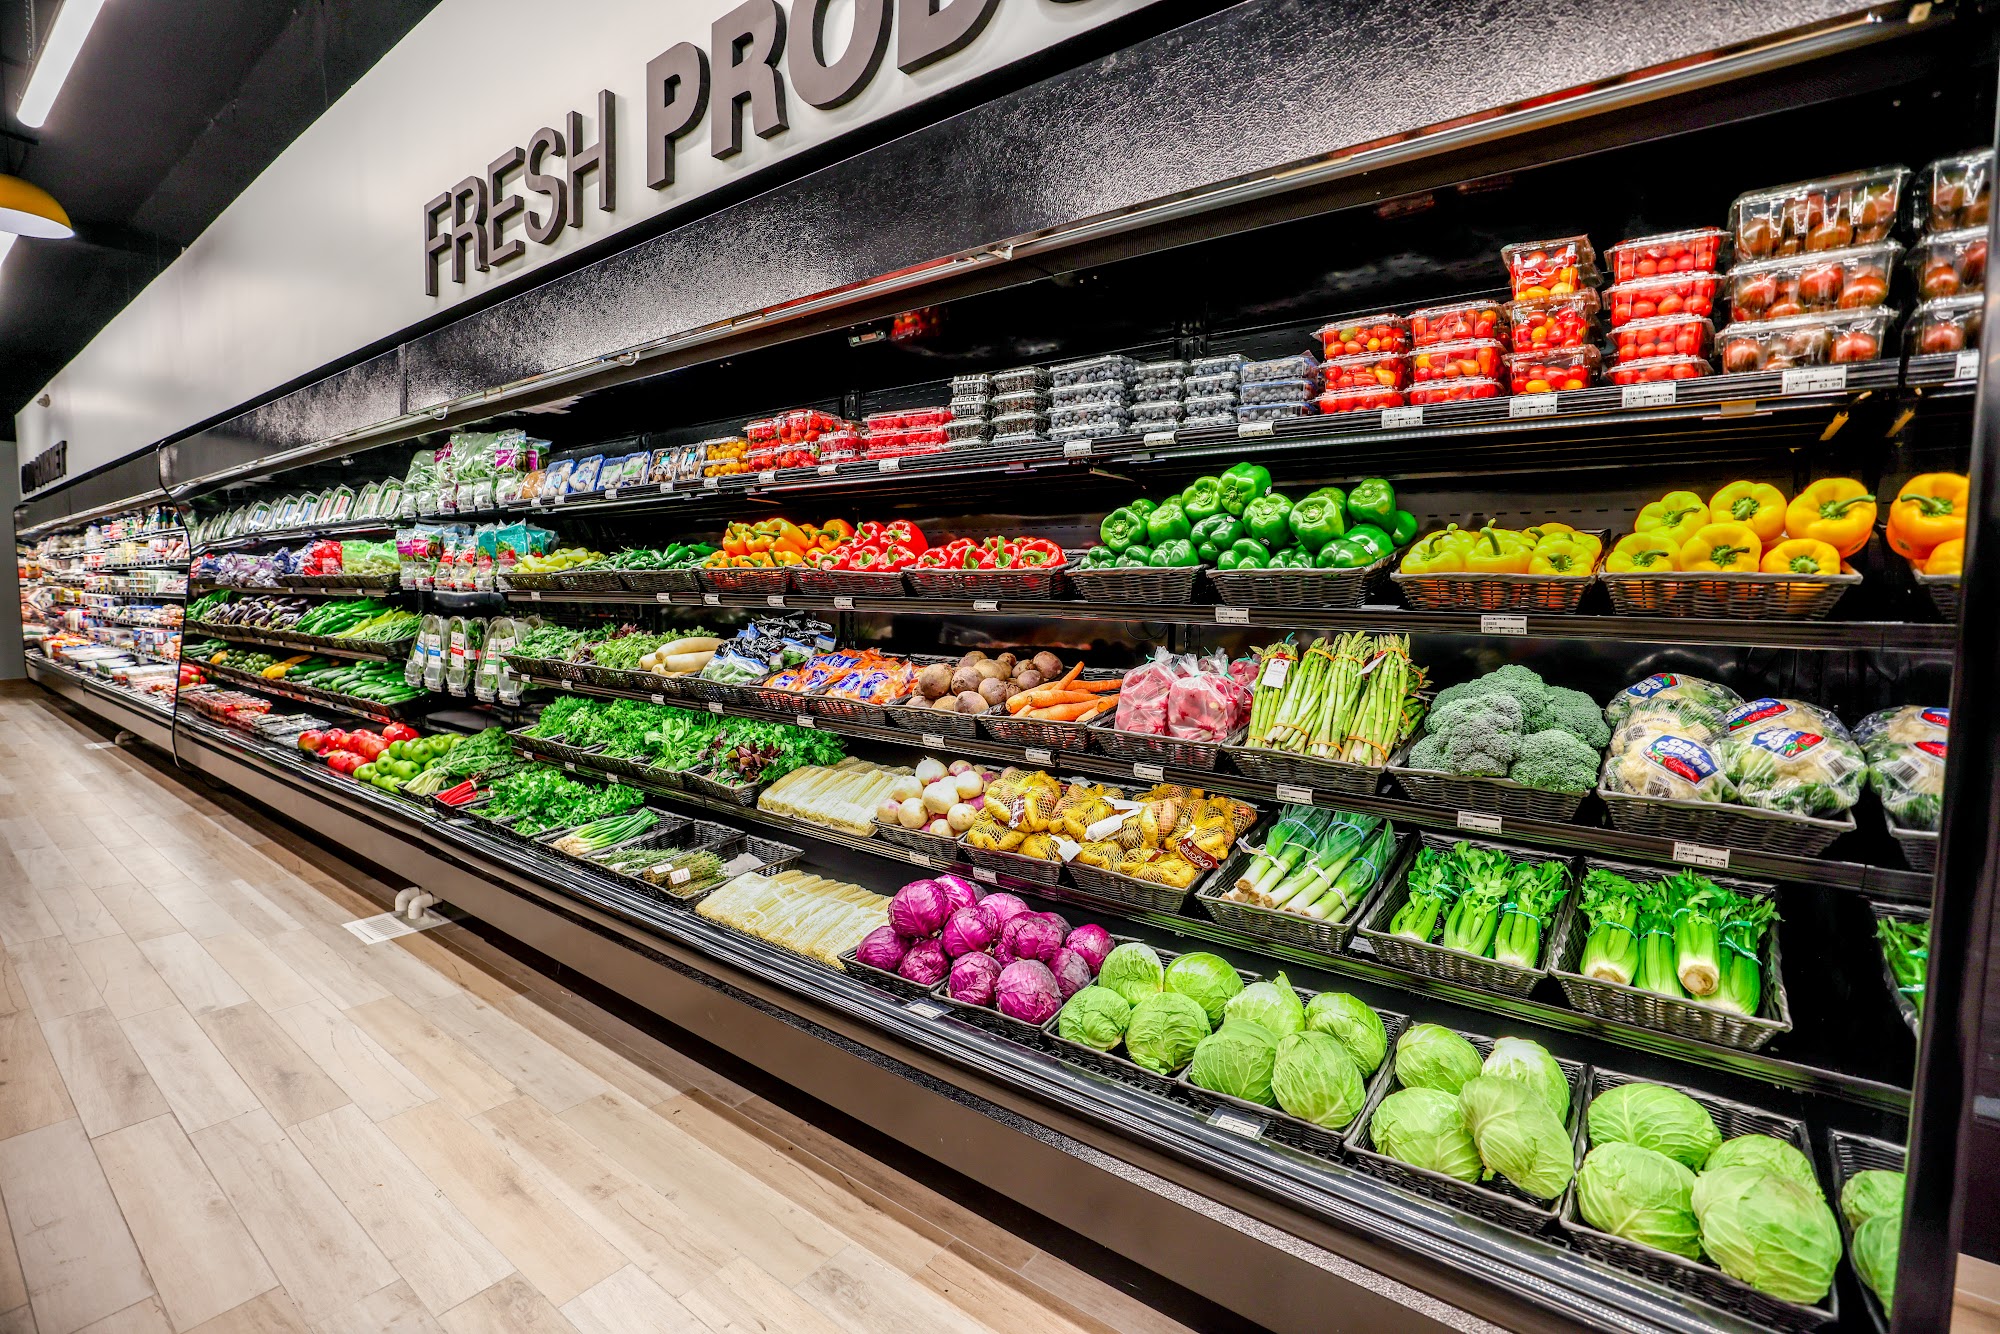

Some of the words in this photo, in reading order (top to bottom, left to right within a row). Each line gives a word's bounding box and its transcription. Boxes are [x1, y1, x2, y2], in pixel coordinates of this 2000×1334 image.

[424, 88, 615, 297] FRESH
[1656, 740, 1711, 773] Canyon
[1181, 843, 1213, 869] Organic
